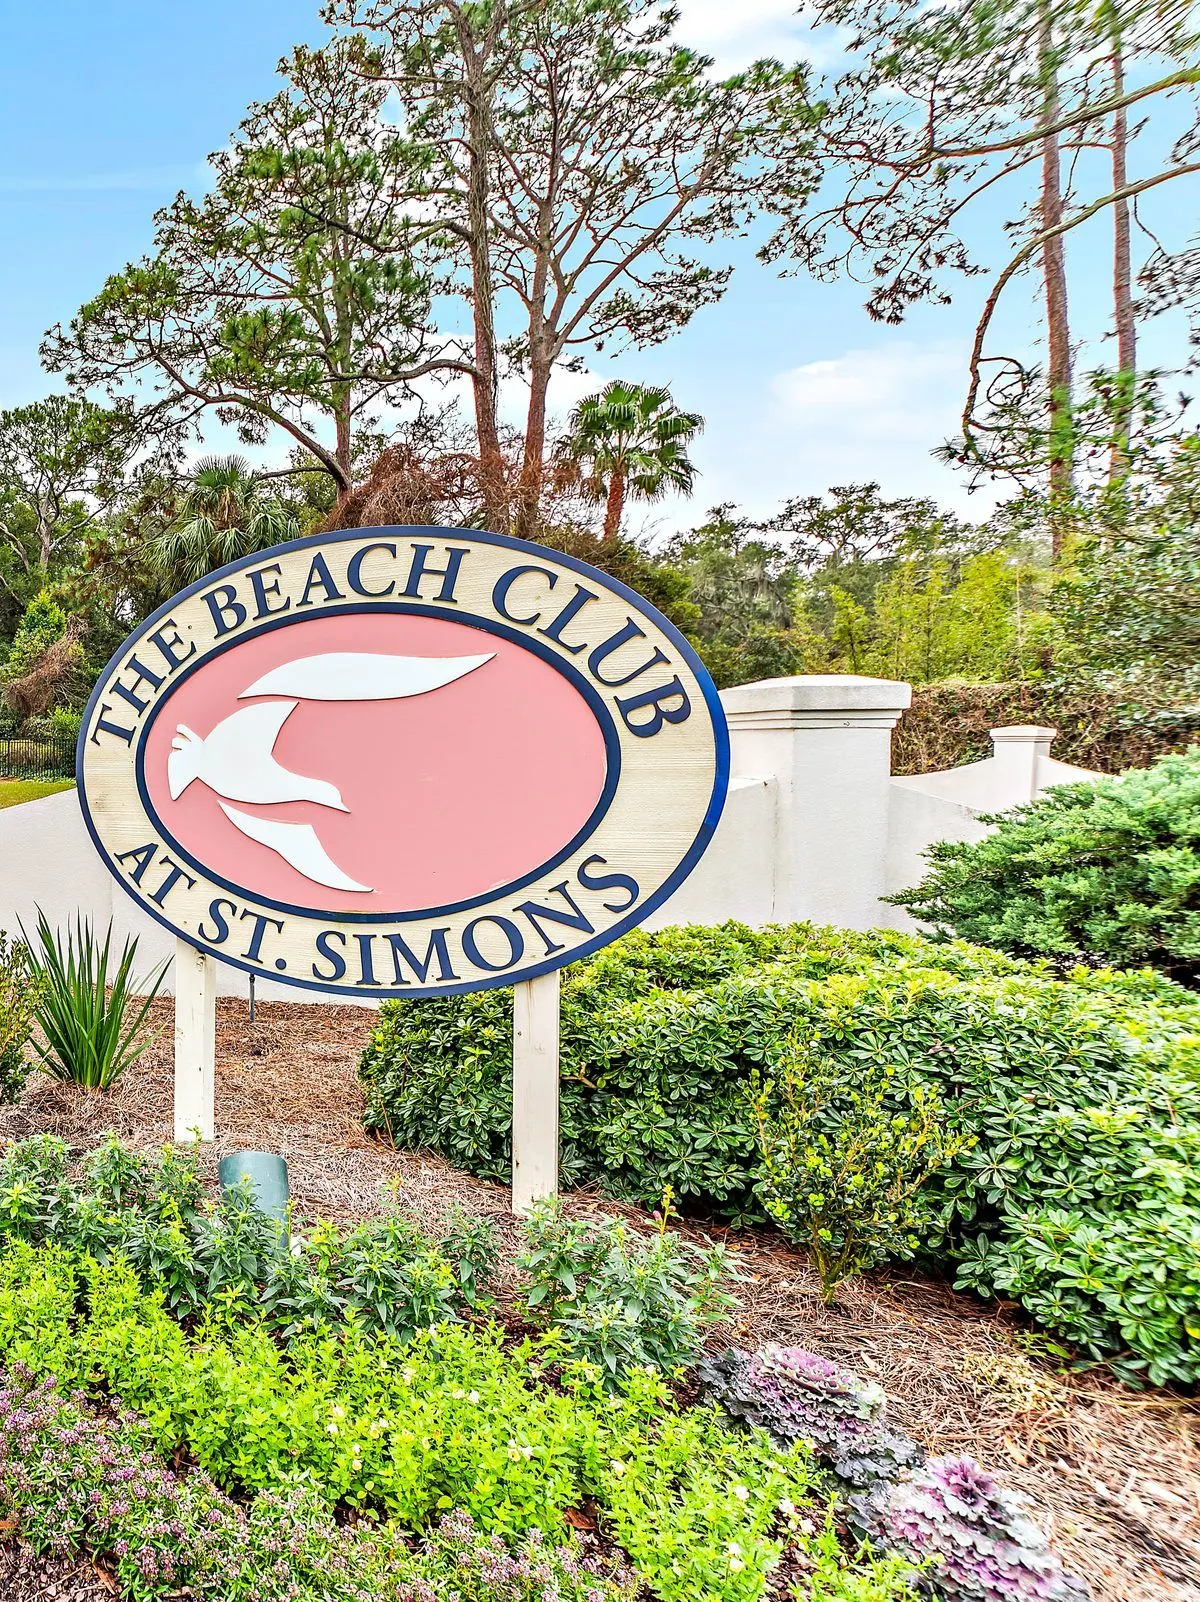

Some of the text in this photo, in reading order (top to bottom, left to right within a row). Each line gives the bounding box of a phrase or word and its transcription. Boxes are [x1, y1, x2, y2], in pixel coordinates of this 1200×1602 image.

[91, 542, 692, 748] THE BEACH CLUB
[113, 842, 640, 987] AT ST. SIMONS
